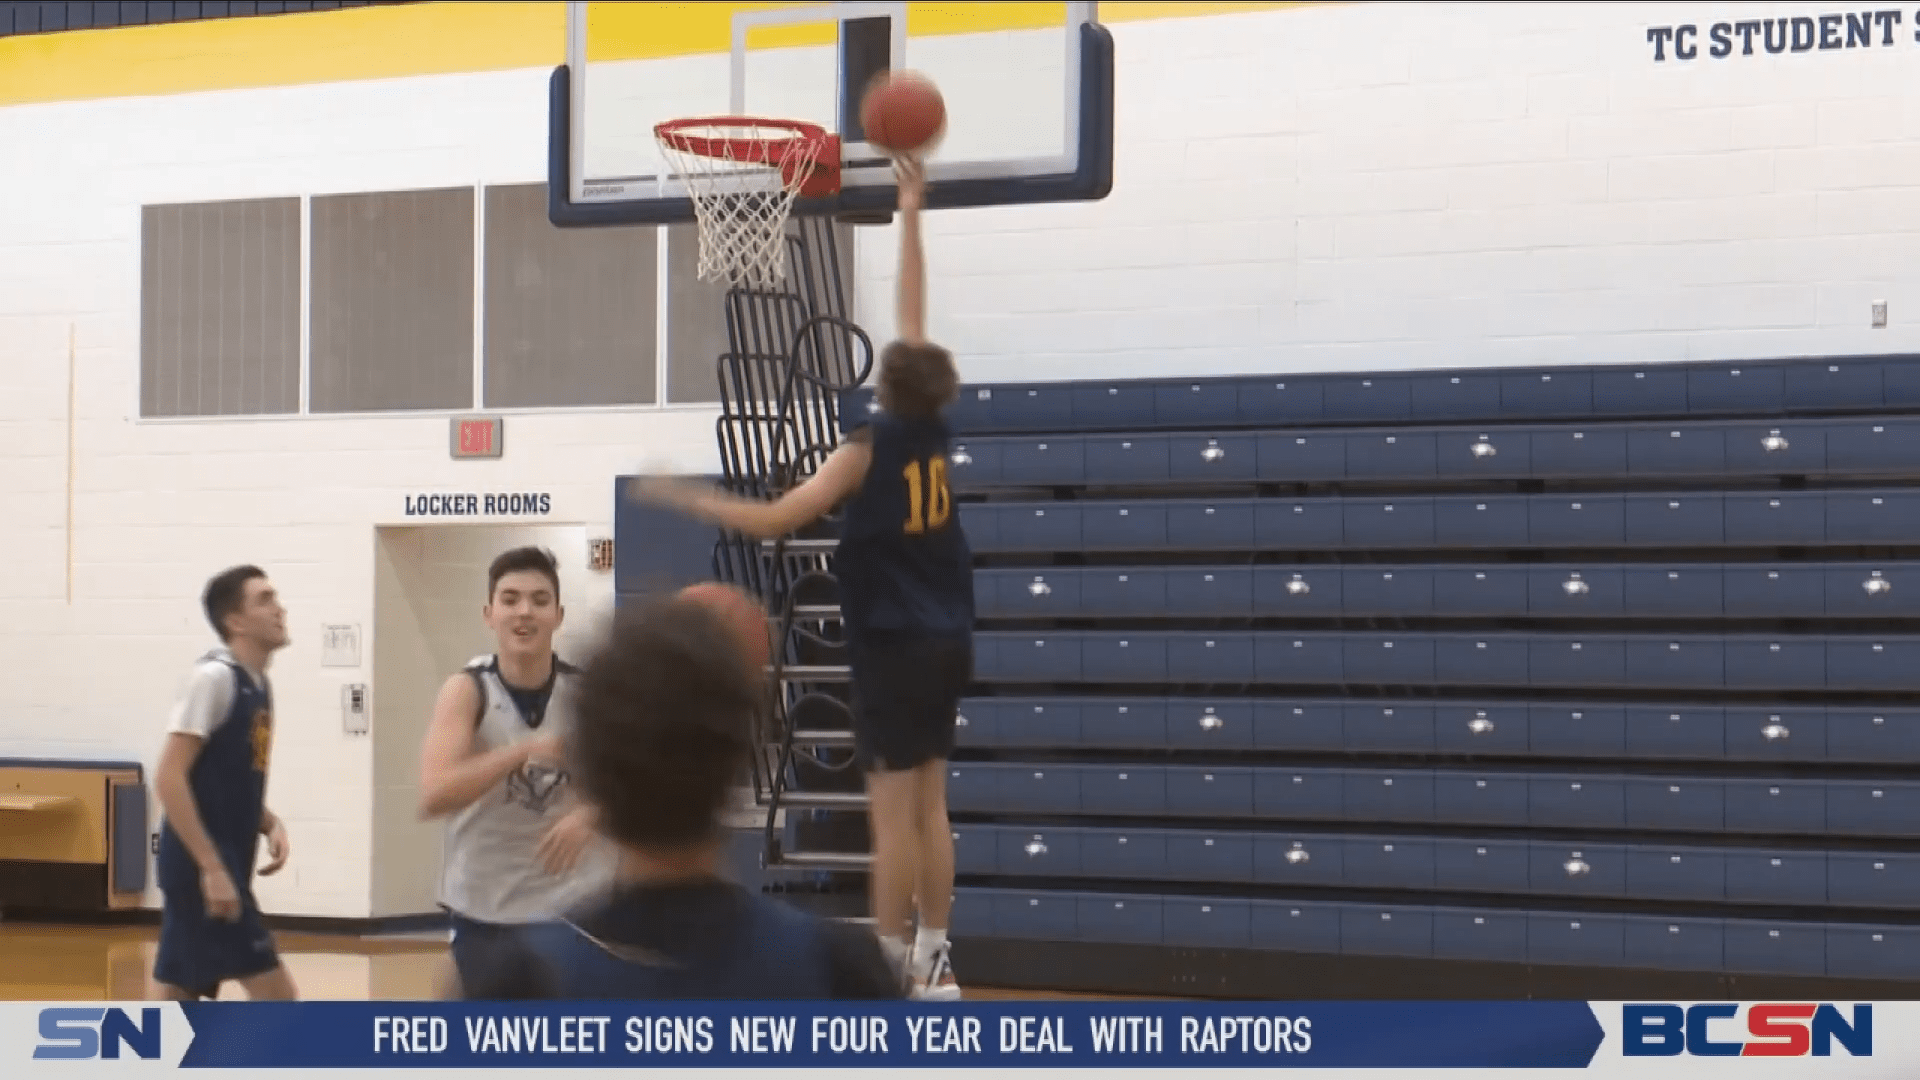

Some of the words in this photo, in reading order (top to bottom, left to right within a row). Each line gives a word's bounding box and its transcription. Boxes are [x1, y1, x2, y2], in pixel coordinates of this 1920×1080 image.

[1646, 25, 1698, 62] TC
[1709, 10, 1902, 59] STUDENT
[405, 493, 478, 516] LOCKER
[483, 492, 551, 515] ROOMS
